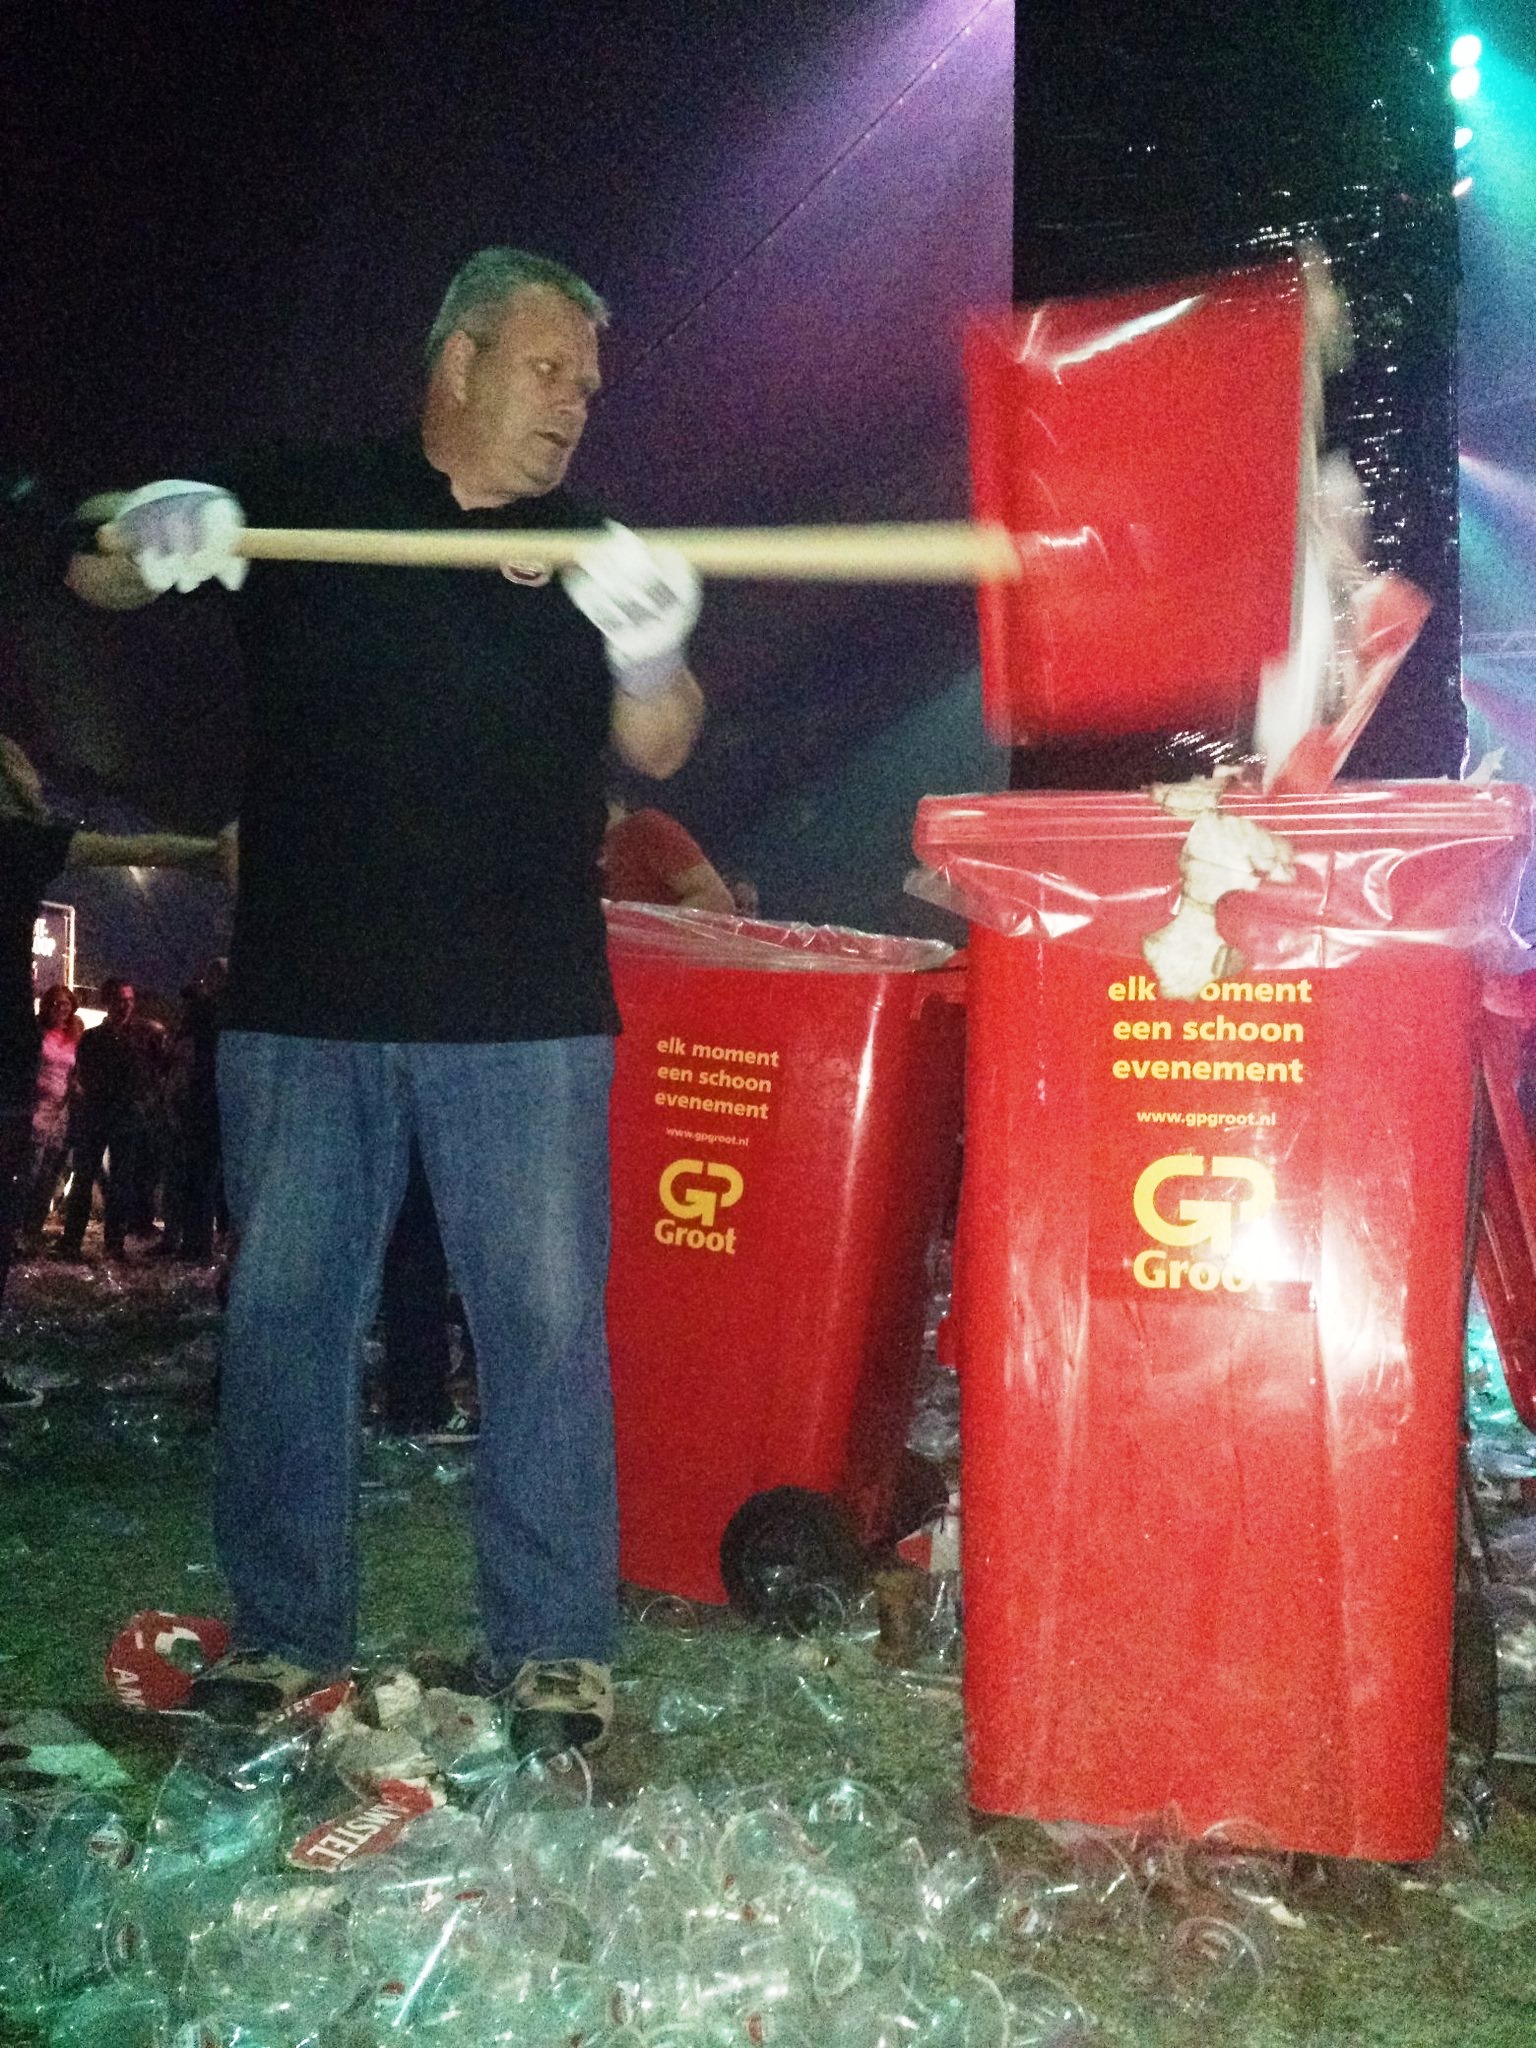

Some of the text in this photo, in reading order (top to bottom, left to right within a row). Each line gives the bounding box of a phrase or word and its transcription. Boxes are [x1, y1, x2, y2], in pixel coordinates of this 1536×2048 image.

[1108, 976, 1312, 1003] elk oment
[1113, 1015, 1304, 1042] een schoon
[657, 1037, 780, 1068] elk moment
[657, 1065, 772, 1093] een schoon
[1112, 1058, 1304, 1083] evenement
[655, 1091, 769, 1120] evenement
[1136, 1110, 1277, 1127] www.gpgroot.nl
[666, 1127, 750, 1146] www.gpgroot.nl
[654, 1219, 737, 1254] Groot
